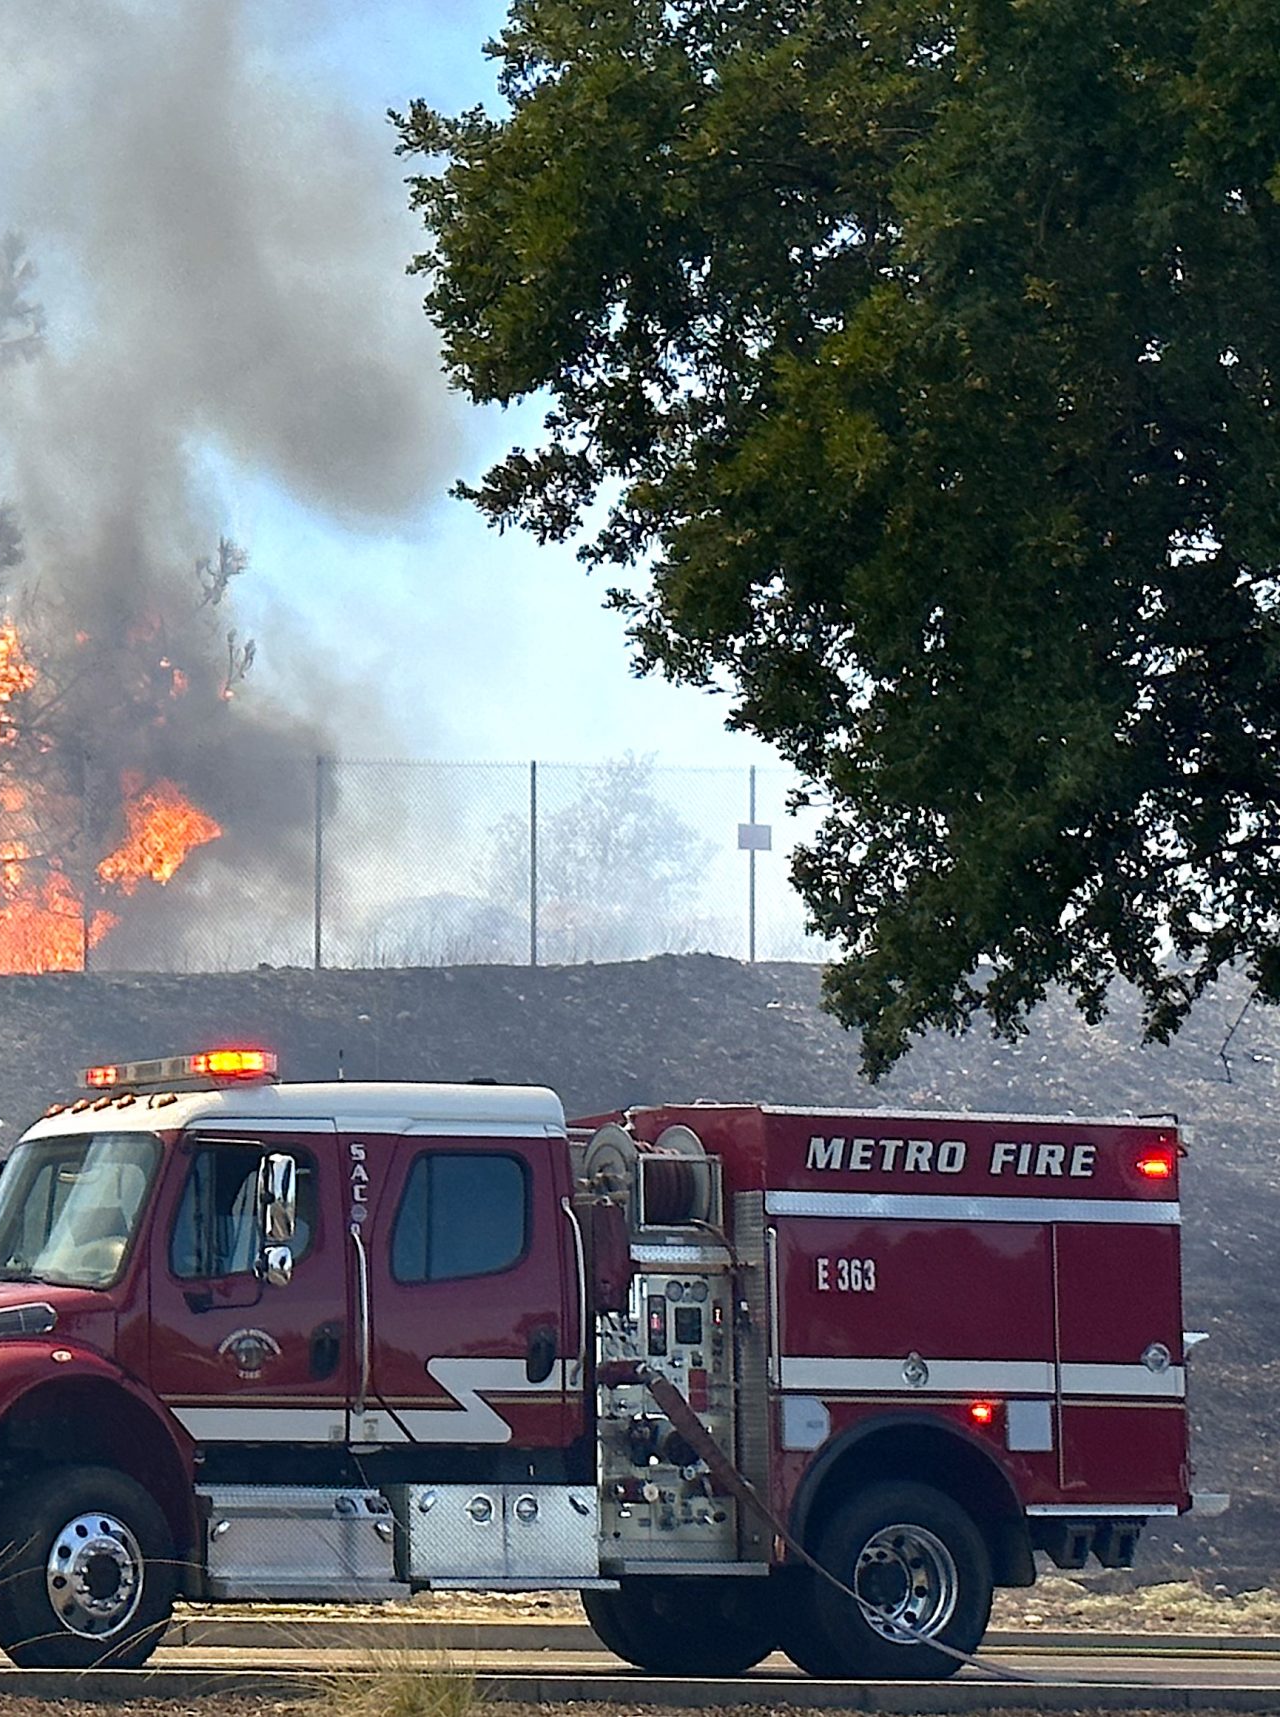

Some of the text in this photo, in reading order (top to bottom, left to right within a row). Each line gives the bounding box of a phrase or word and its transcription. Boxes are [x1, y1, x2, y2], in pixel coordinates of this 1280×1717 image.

[350, 1143, 369, 1202] SAC
[805, 1136, 1097, 1177] METRO FIRE
[816, 1257, 876, 1292] E 363
